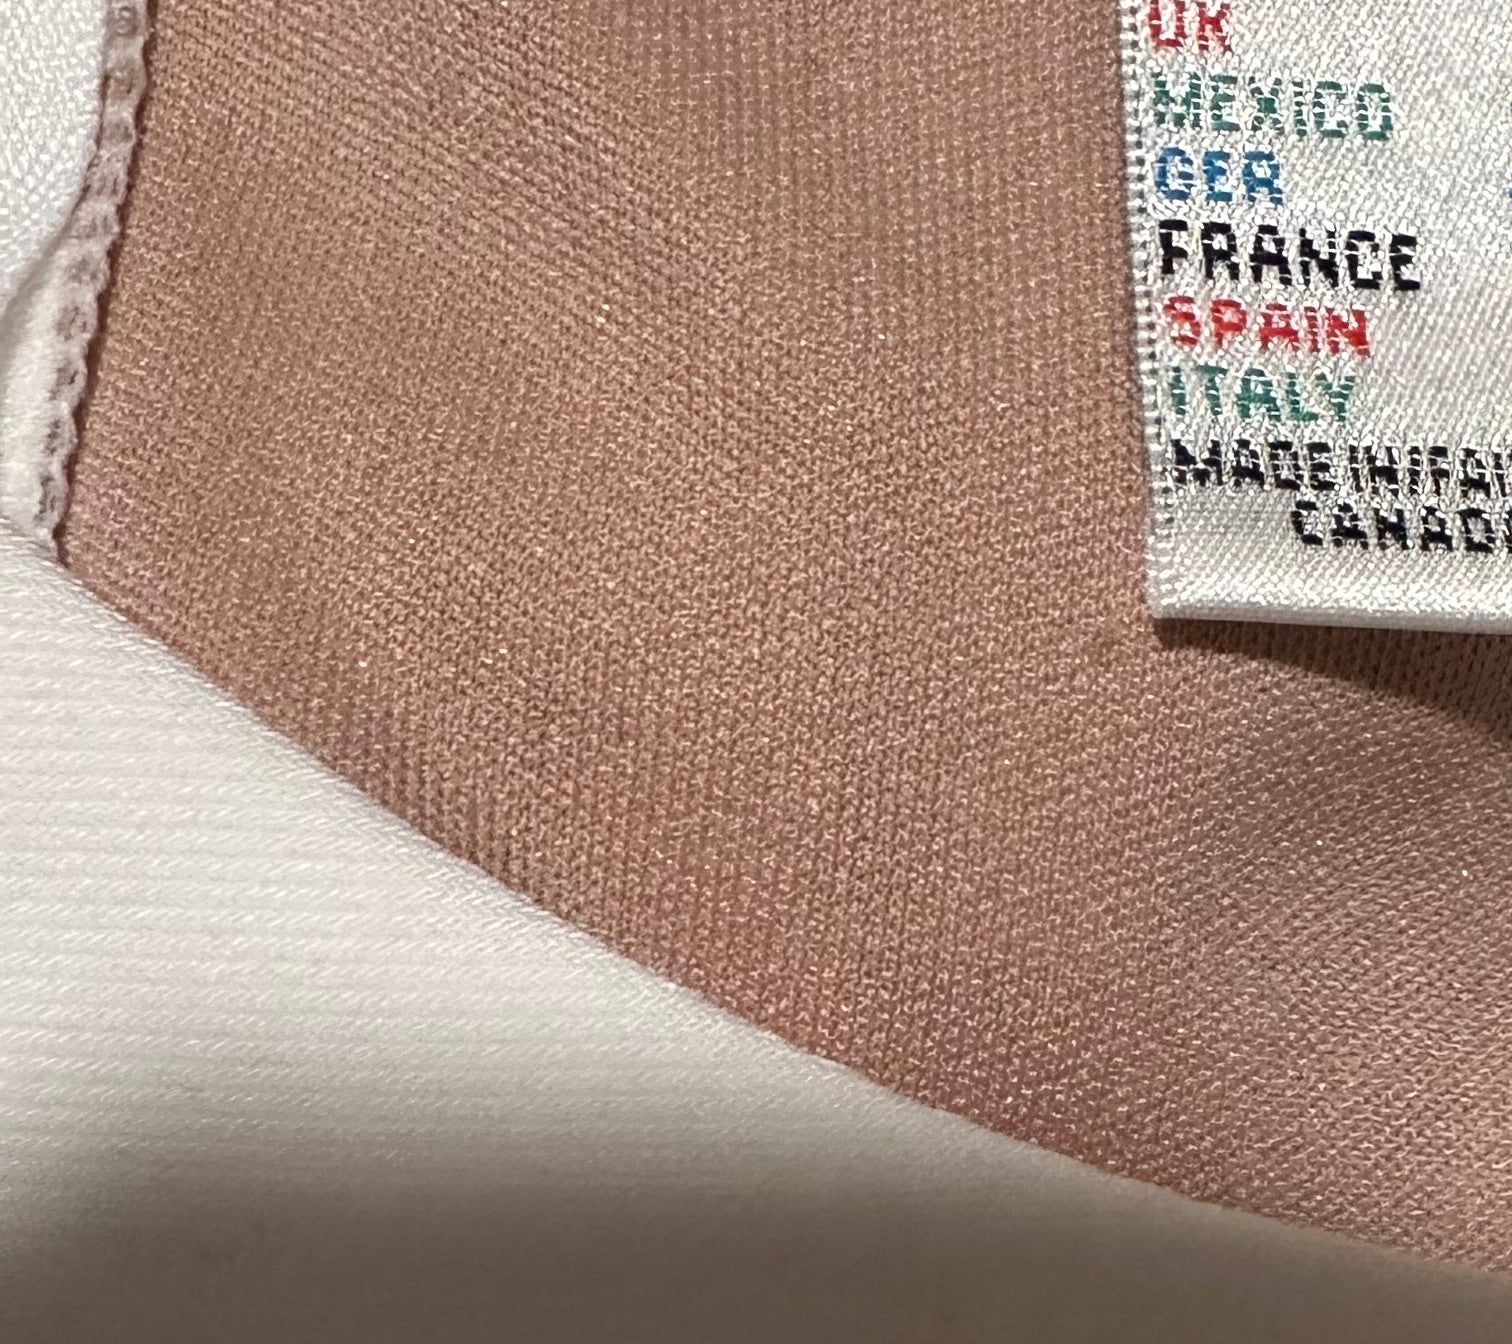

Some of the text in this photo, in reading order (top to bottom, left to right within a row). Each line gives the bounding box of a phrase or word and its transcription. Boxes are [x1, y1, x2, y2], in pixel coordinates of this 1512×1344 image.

[1147, 0, 1232, 53] UK
[1150, 72, 1394, 141] MEXICO
[1154, 147, 1284, 205] GER
[1158, 219, 1422, 291] FRANCE
[1163, 295, 1371, 358] SPAIN
[1168, 365, 1354, 424] ITALY
